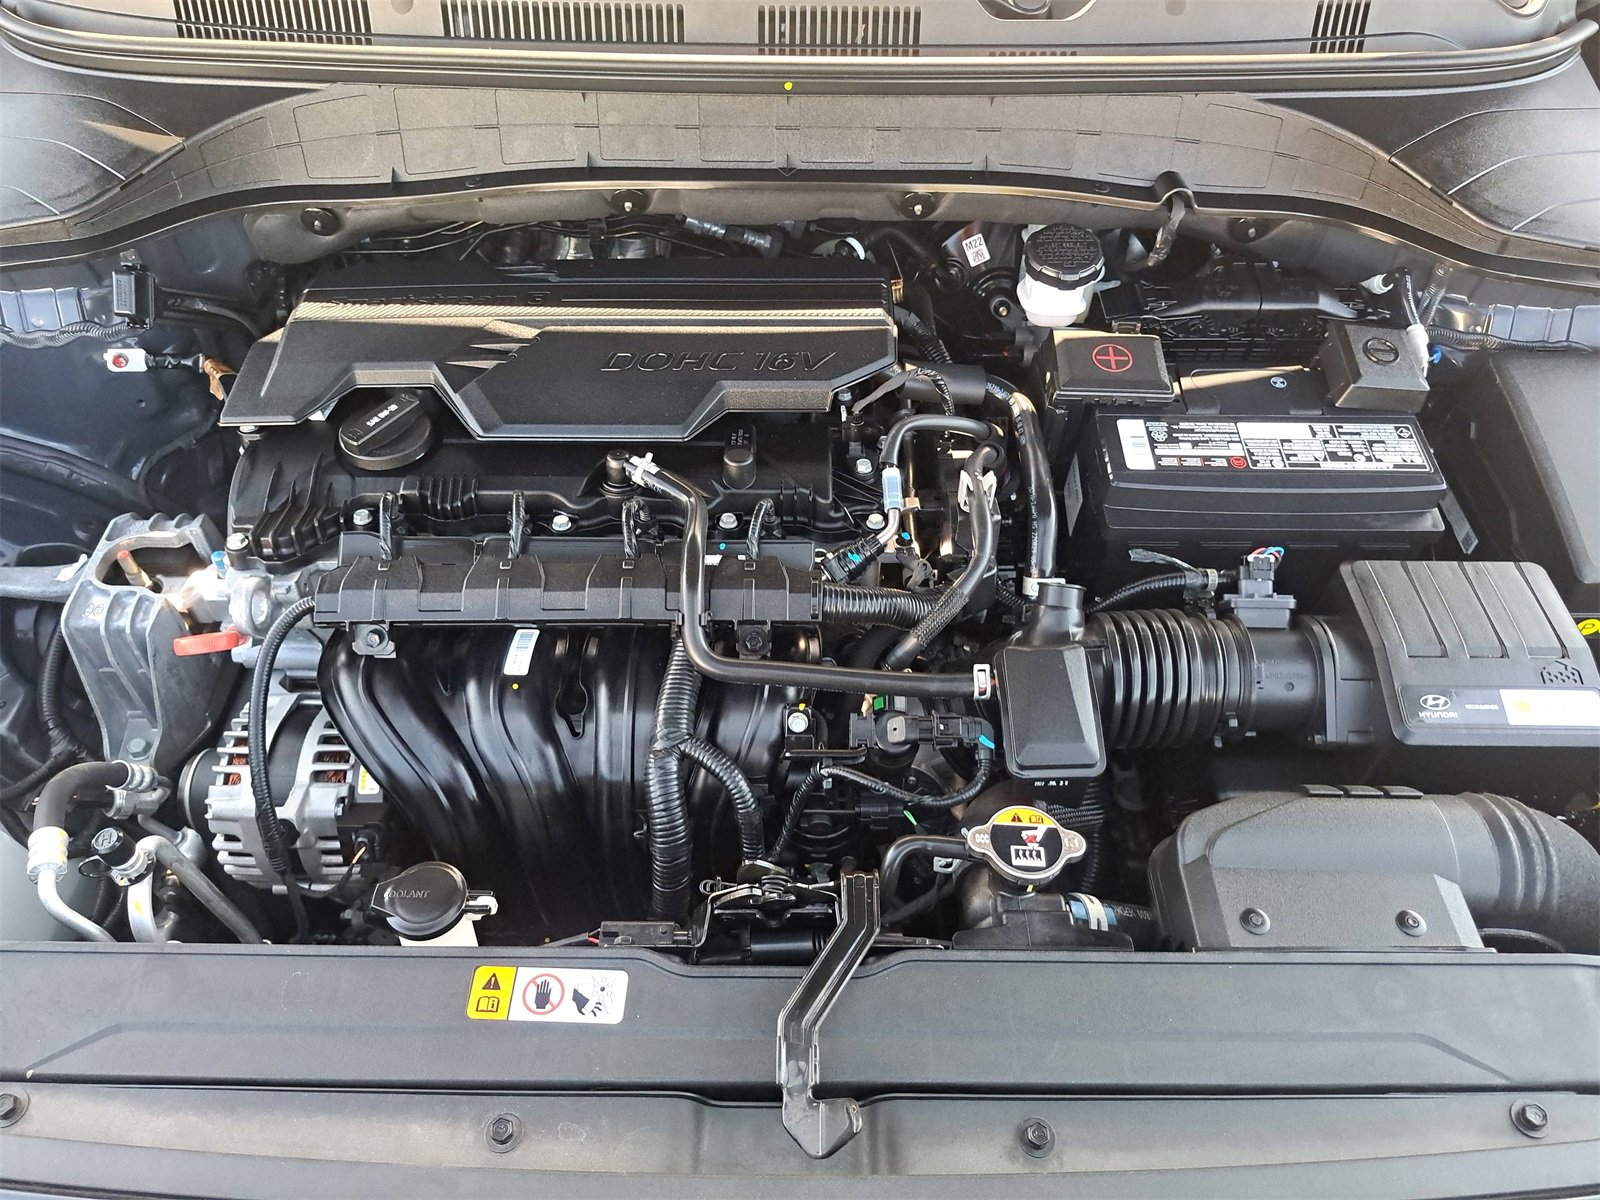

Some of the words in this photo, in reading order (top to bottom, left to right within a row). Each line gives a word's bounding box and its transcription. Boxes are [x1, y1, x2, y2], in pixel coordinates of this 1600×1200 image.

[964, 236, 984, 251] M22
[600, 351, 744, 371] DOHC
[752, 351, 837, 371] 16V
[1418, 711, 1459, 719] HYUNDAI
[384, 889, 430, 899] OOLANT
